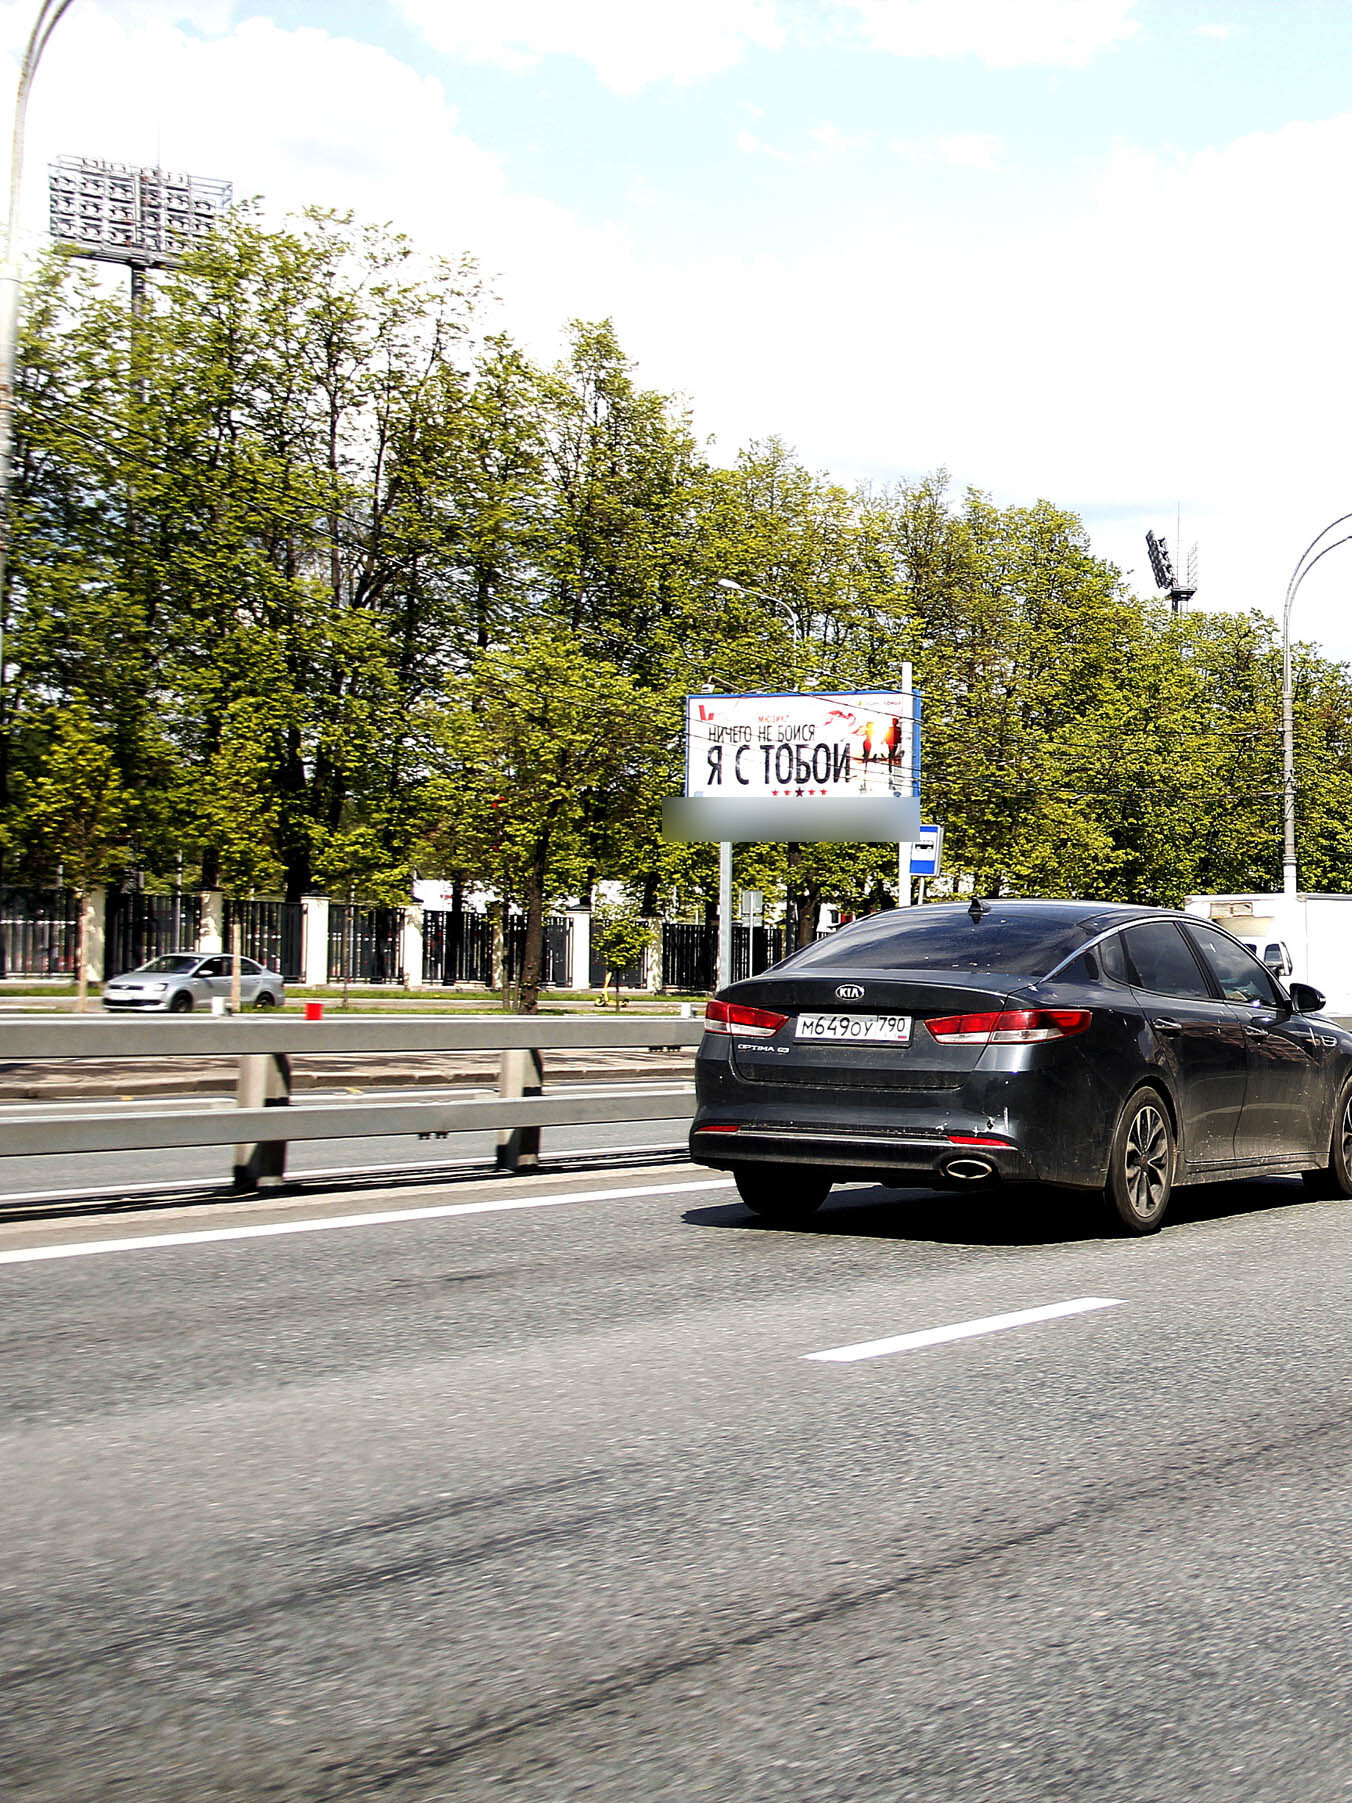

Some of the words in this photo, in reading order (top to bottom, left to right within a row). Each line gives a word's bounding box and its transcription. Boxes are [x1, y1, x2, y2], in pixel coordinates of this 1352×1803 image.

[708, 725, 752, 743] НИЧЕГО
[758, 724, 773, 743] НЕ
[707, 745, 723, 785] Я
[735, 744, 751, 785] С
[760, 739, 851, 785] ТОБОЙ
[839, 987, 860, 998] KIA
[737, 1043, 775, 1052] OPTIMA
